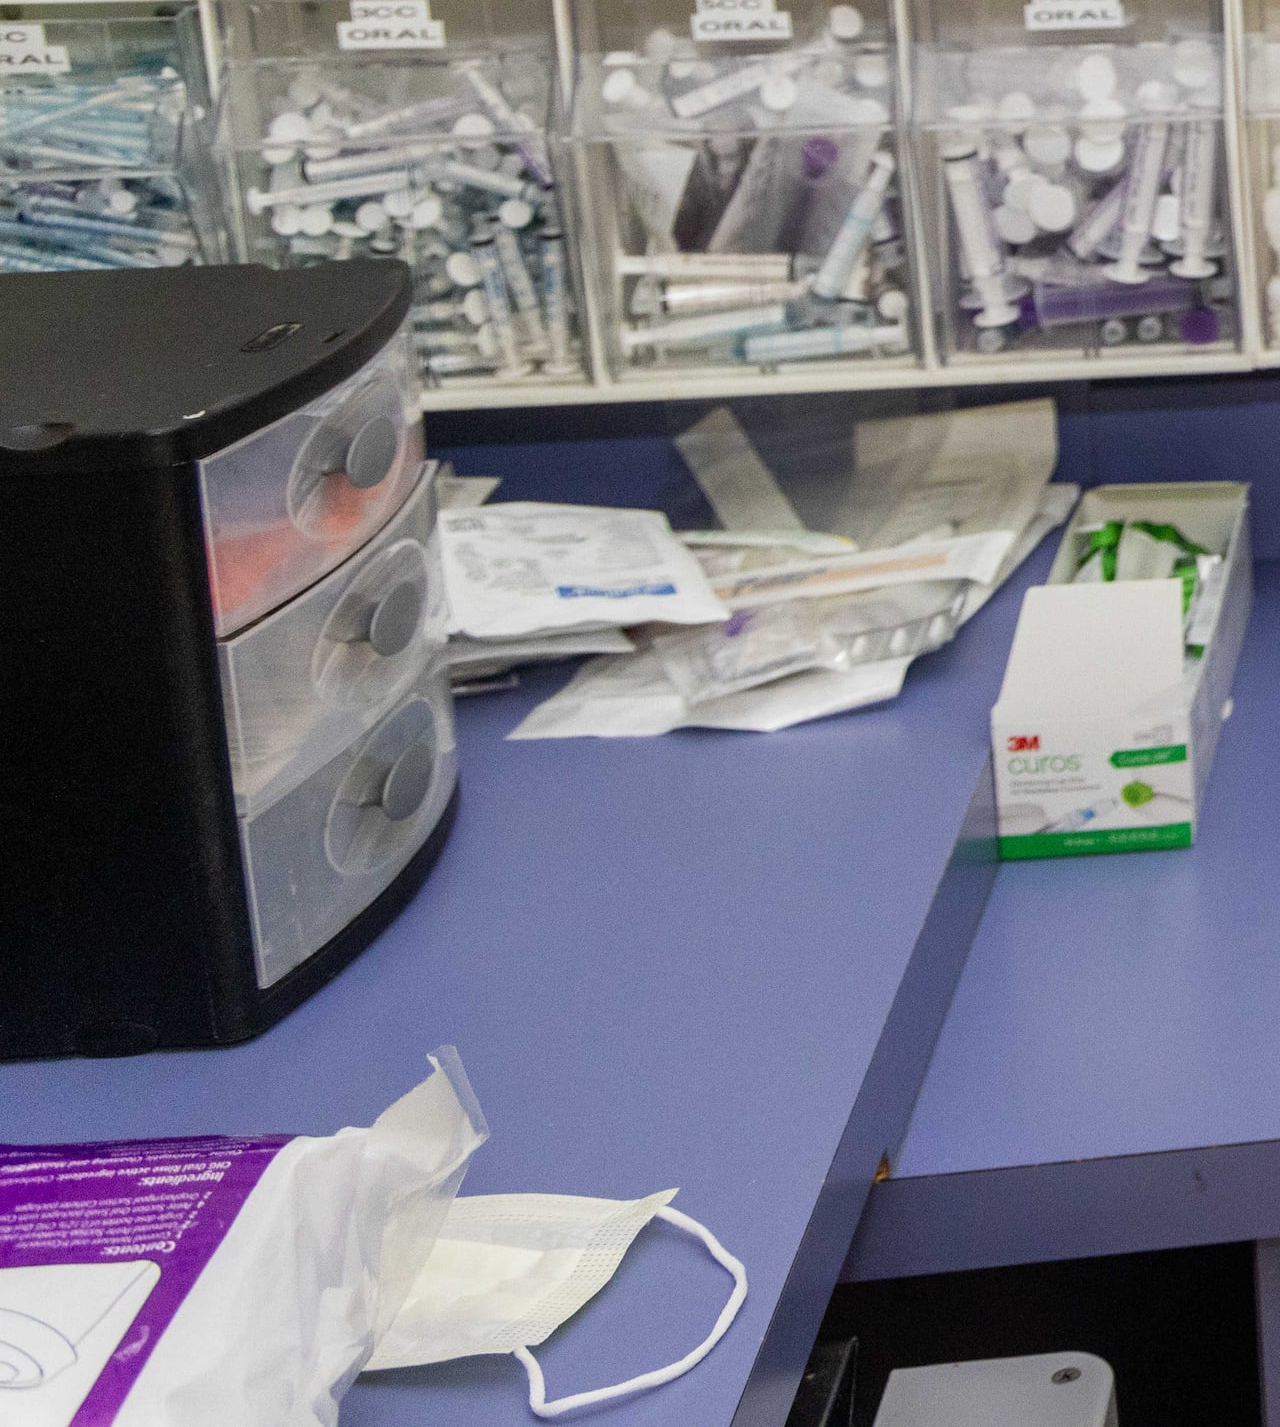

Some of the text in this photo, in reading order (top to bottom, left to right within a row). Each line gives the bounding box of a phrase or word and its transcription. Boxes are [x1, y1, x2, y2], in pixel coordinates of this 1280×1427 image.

[353, 6, 417, 19] 3CC
[1033, 9, 1118, 23] ORAL
[699, 20, 787, 33] ORAL
[347, 28, 438, 41] ORAL
[1007, 734, 1041, 752] 3M
[1008, 754, 1081, 775] curos
[117, 1166, 151, 1176] active
[182, 1163, 207, 1172] Oral
[55, 1169, 116, 1181] ingredient:
[138, 1169, 225, 1187] Ingredients:
[100, 1241, 176, 1256] Contents:
